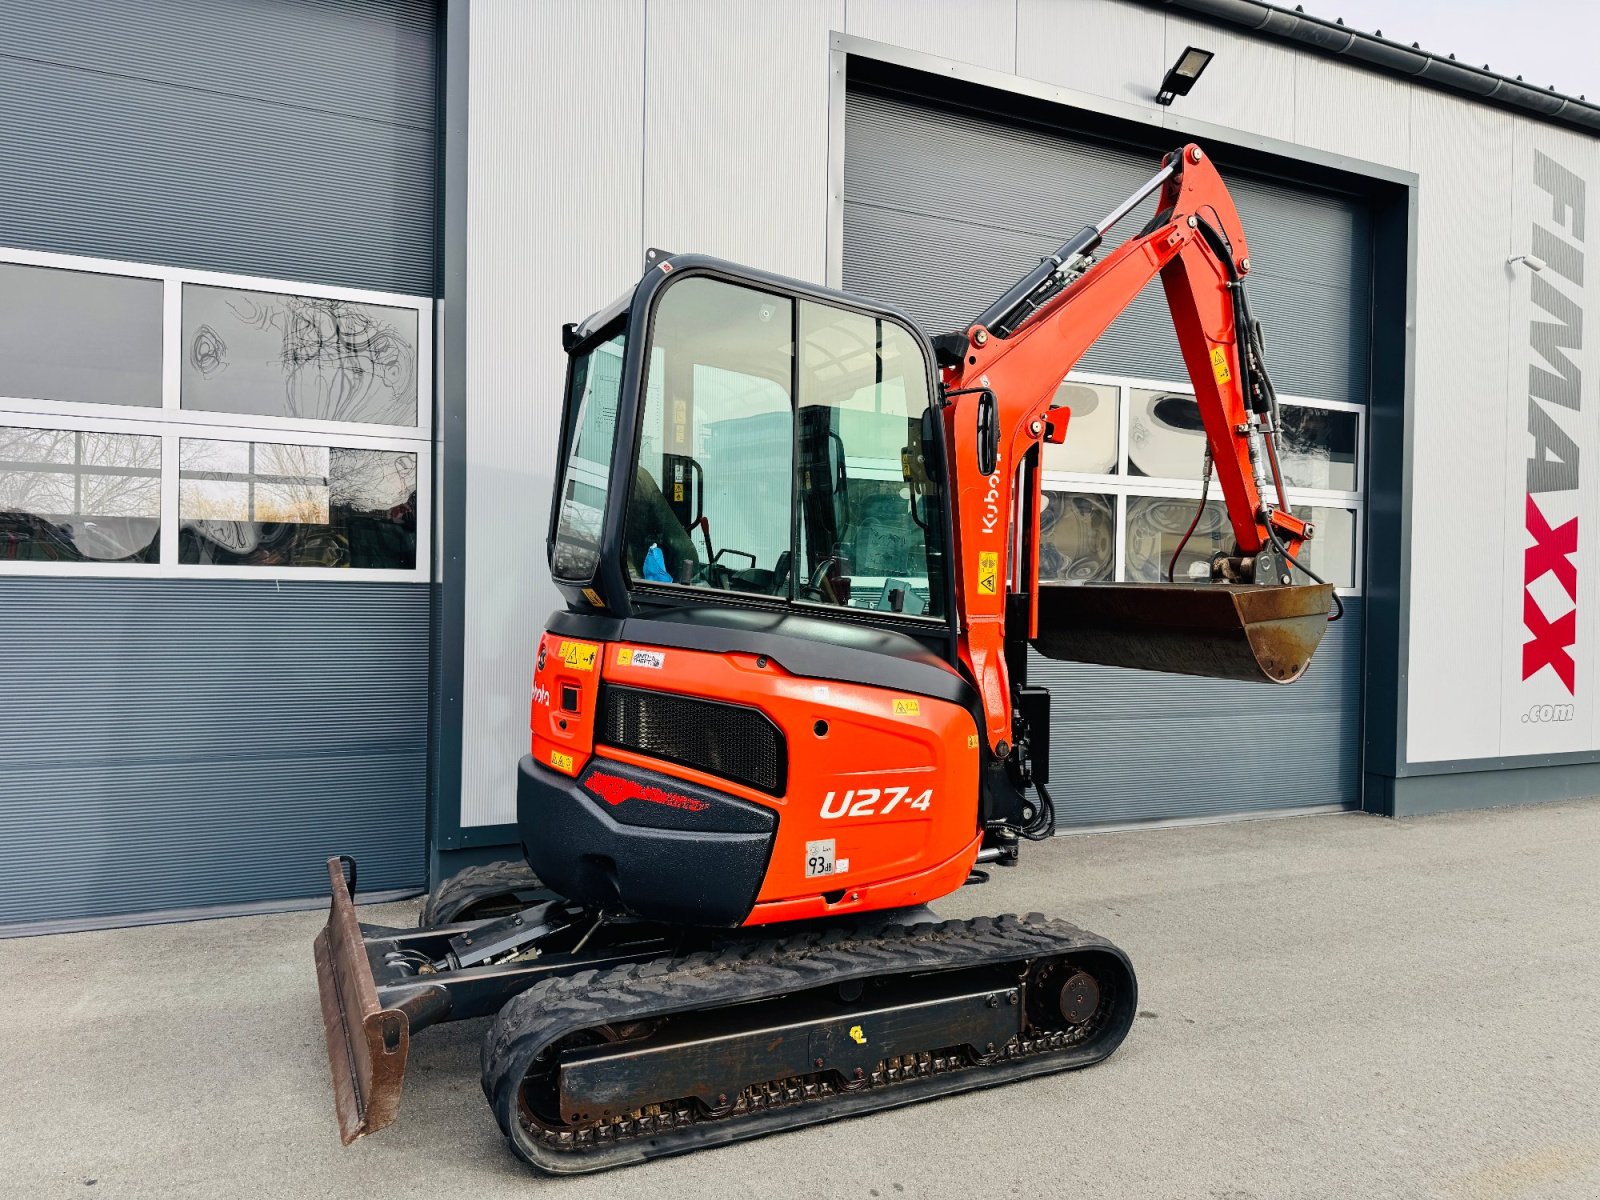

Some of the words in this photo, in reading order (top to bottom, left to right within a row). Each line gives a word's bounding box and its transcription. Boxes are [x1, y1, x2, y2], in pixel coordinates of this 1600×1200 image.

[1522, 148, 1585, 696] FIMAXX
[982, 453, 1001, 534] Kubo
[1521, 703, 1574, 723] .com
[819, 786, 933, 819] U27-4
